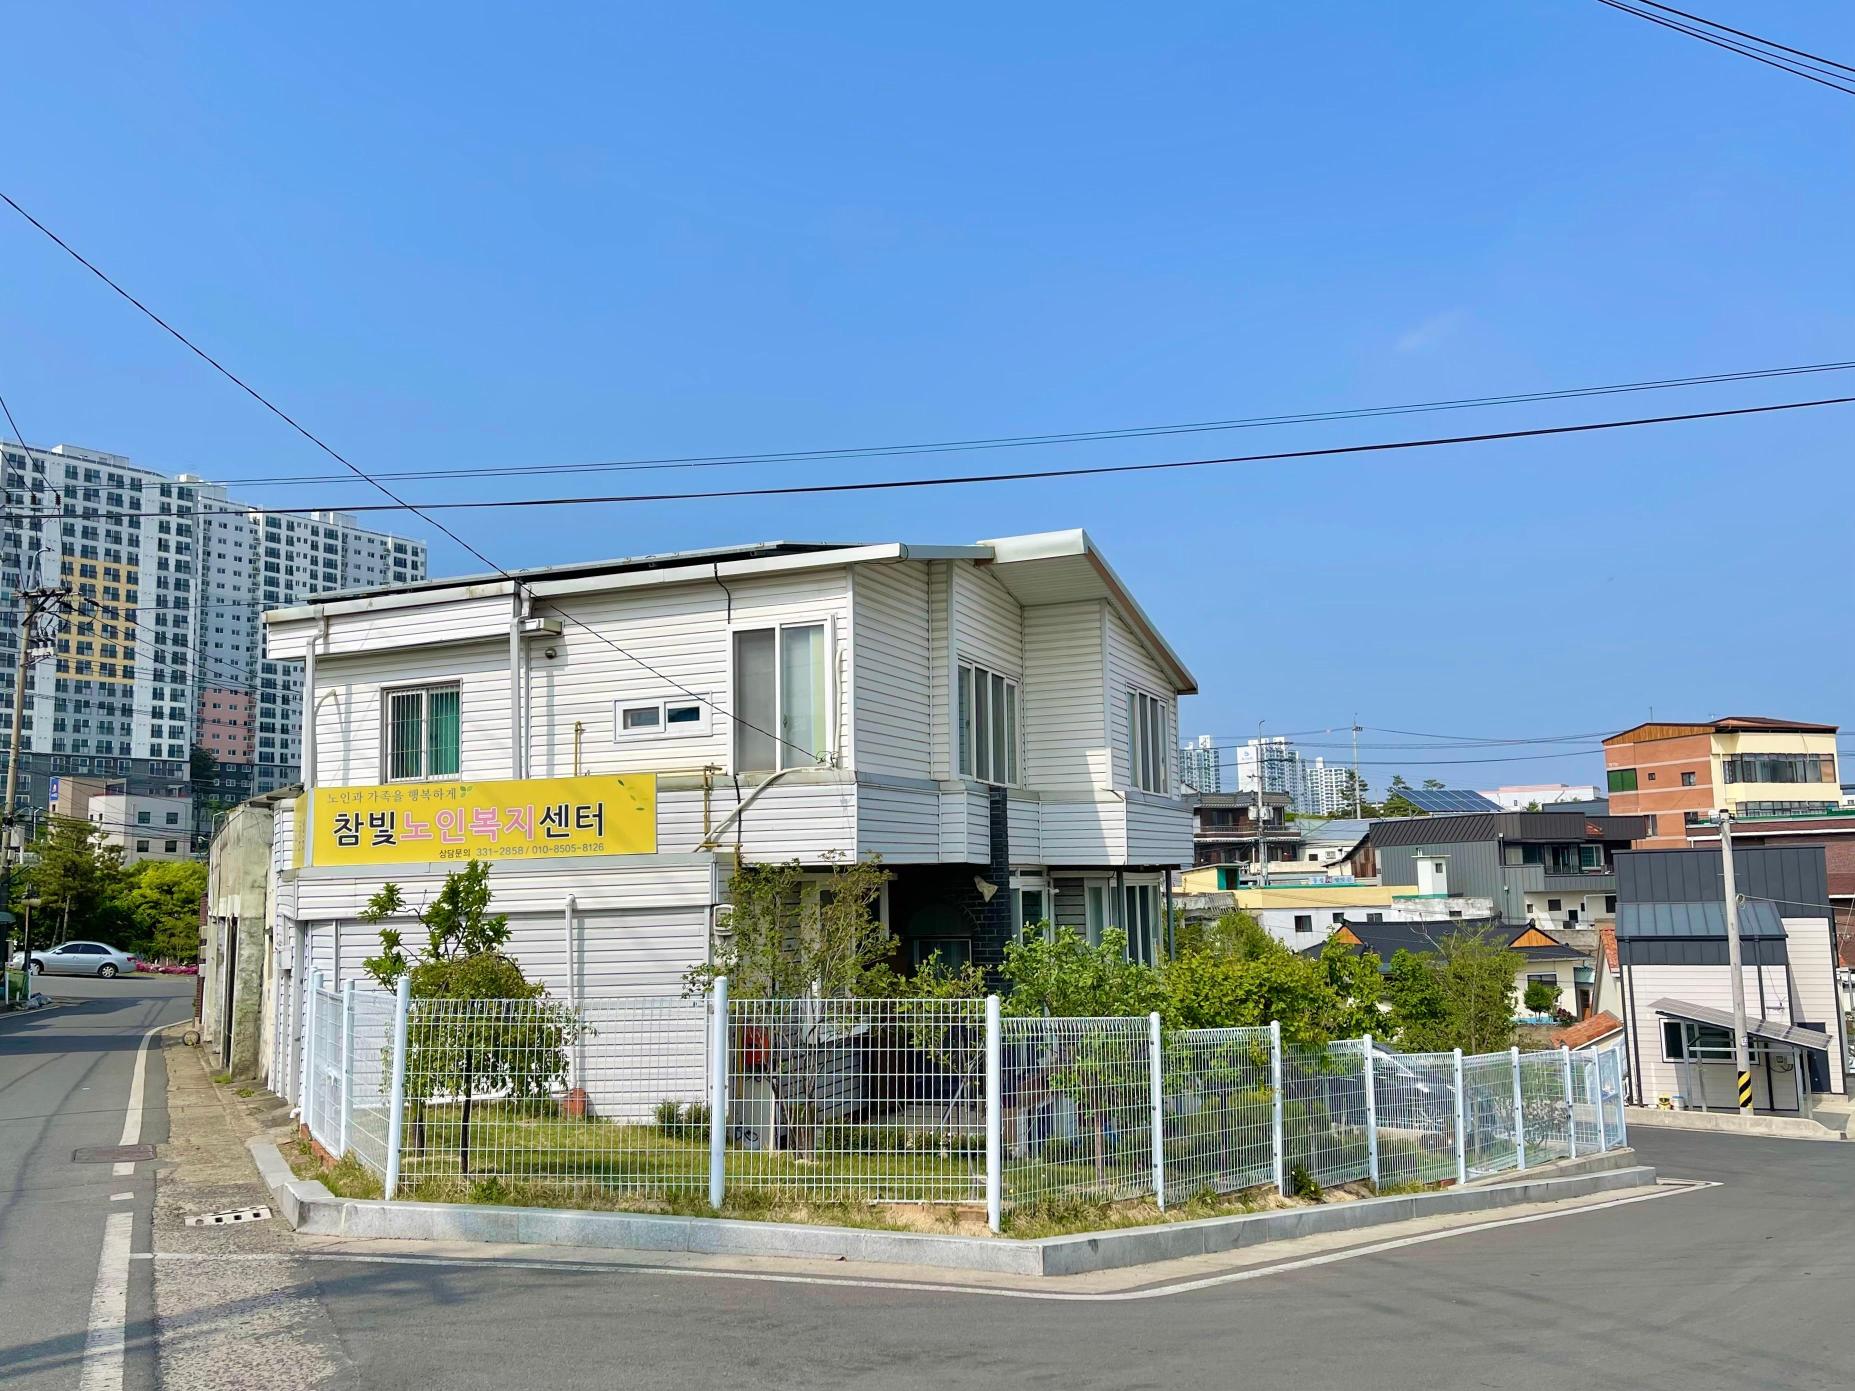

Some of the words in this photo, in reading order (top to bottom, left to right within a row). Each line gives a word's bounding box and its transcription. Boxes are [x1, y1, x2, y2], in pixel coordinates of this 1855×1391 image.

[328, 791, 363, 804] 노인과
[367, 789, 403, 803] 가족을
[408, 788, 457, 801] 행복하게
[332, 802, 604, 847] 참빛노인복지센터
[439, 849, 471, 858] 상담문의
[475, 846, 524, 857] 331-2858
[531, 843, 604, 855] 010-8505-8126
